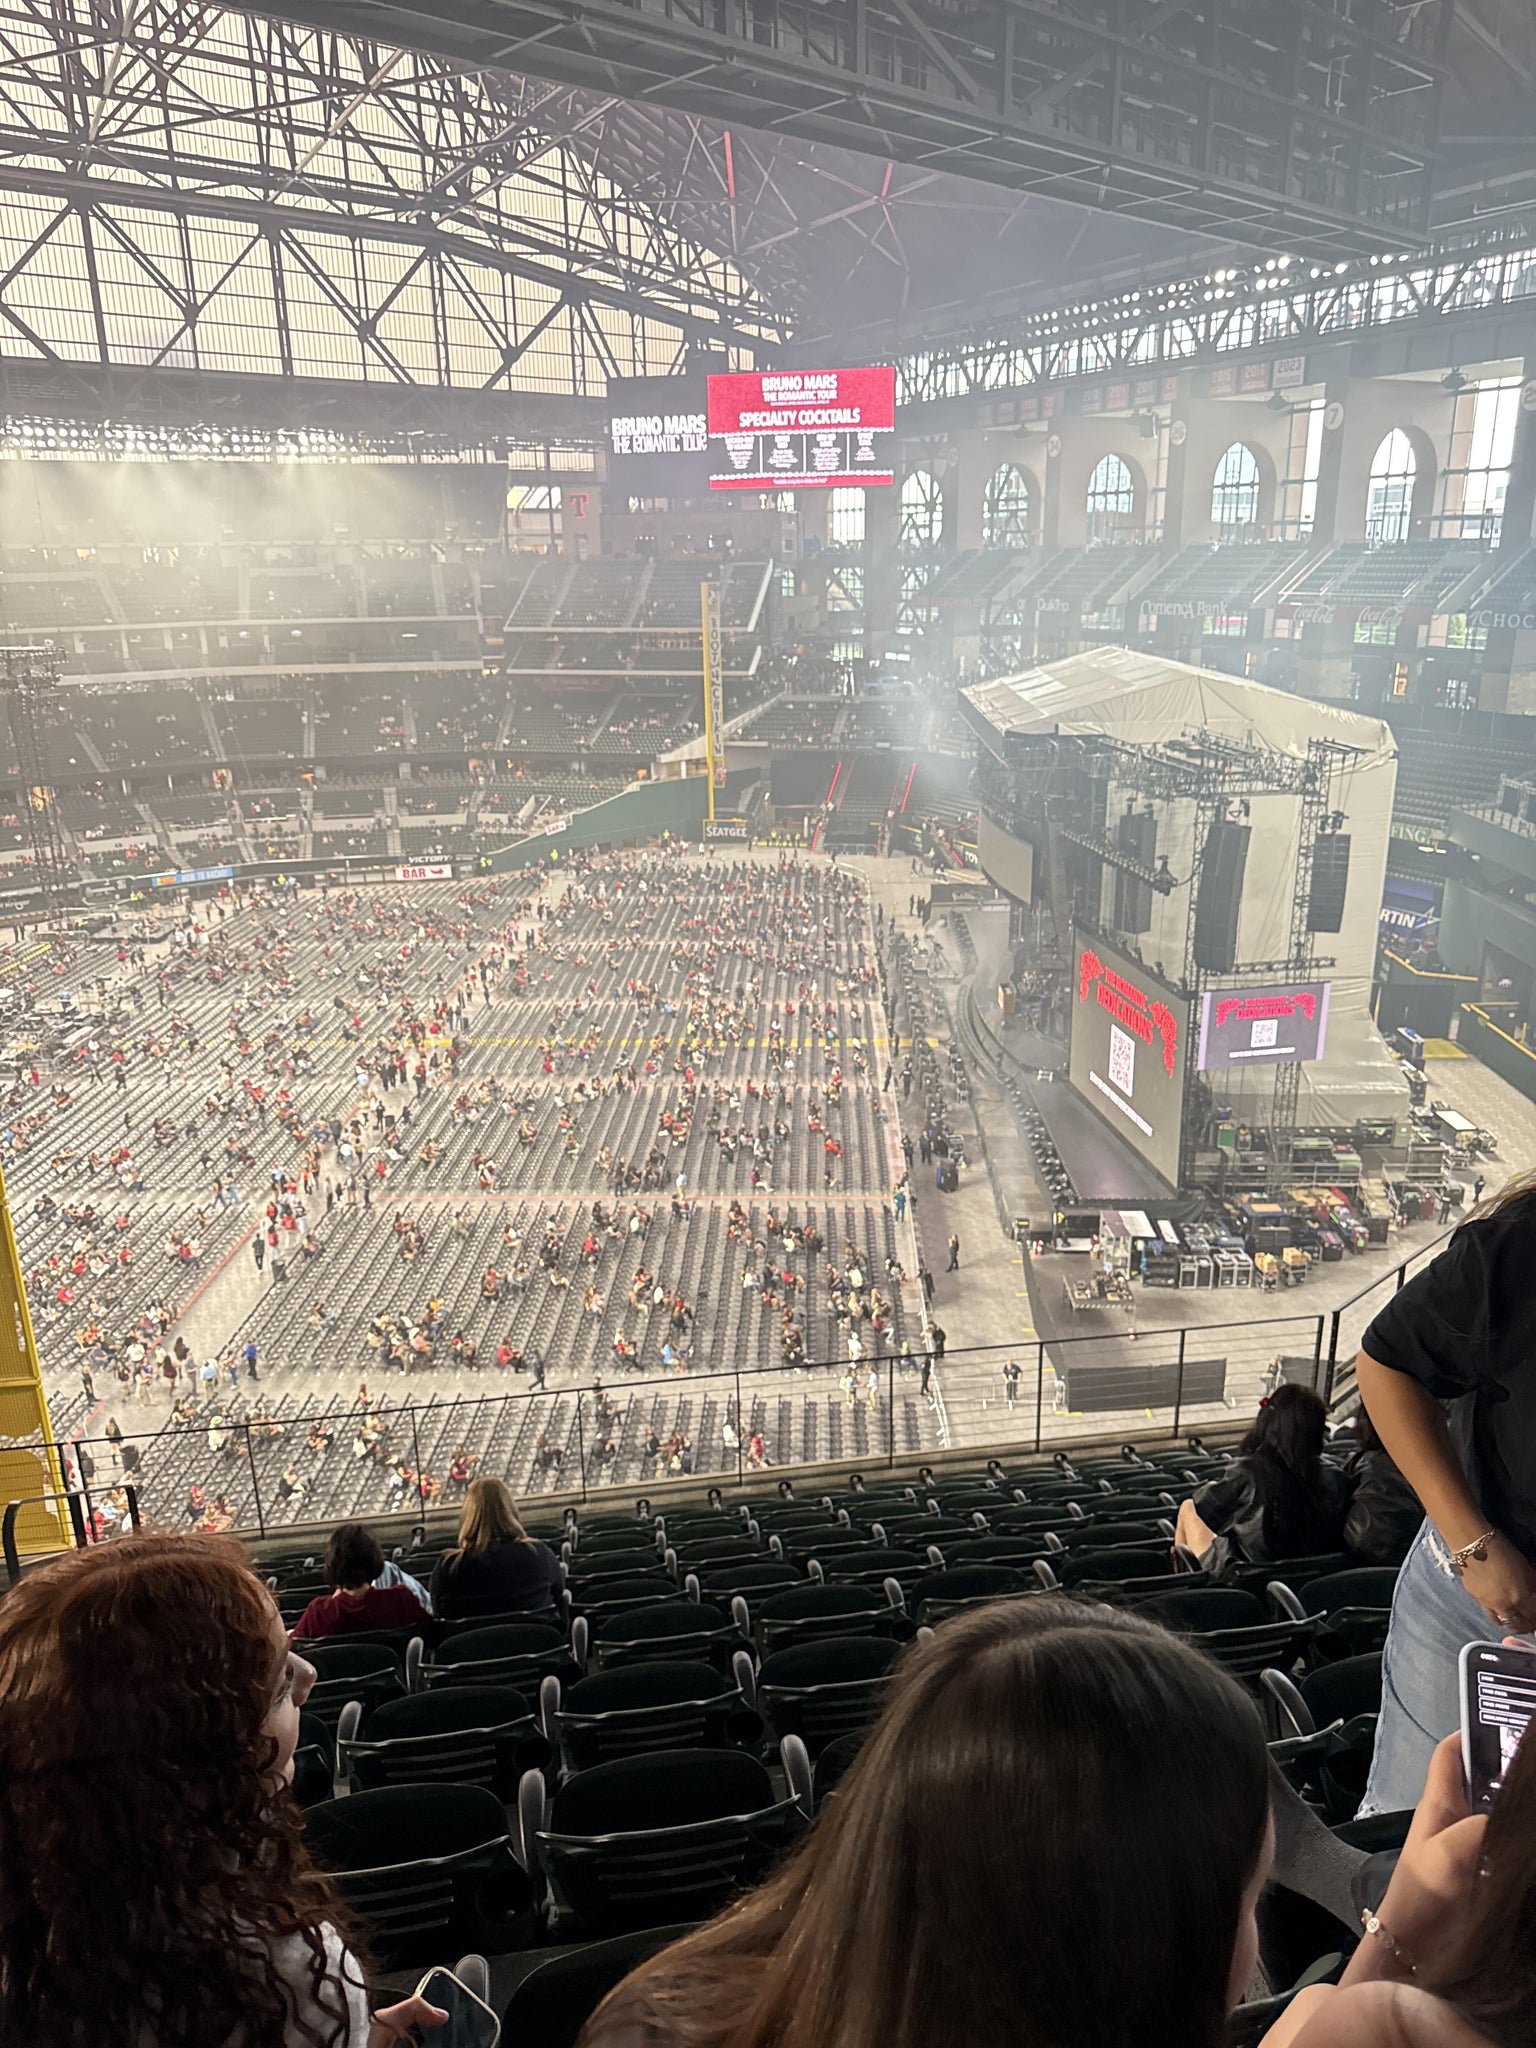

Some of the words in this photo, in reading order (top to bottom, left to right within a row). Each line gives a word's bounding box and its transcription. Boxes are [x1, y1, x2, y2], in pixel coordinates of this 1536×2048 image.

[1278, 359, 1302, 373] 2023
[762, 376, 803, 391] BRUNO
[804, 374, 838, 390] MARS
[763, 392, 778, 402] THE
[778, 390, 816, 401] ROMANTIC
[817, 390, 838, 399] TOUR
[611, 415, 663, 437] BRUNO
[663, 413, 707, 434] MARS
[739, 411, 797, 428] SPECIALTY
[798, 408, 861, 425] COCKTAILS
[611, 436, 632, 454] THE
[632, 434, 681, 453] ROMANTIC
[681, 432, 708, 452] TOUR
[568, 493, 590, 519] T
[1196, 601, 1230, 616] Bank
[408, 855, 451, 863] VICTORY
[402, 868, 426, 879] BAR
[1380, 908, 1416, 929] RTIN
[1097, 980, 1153, 1045] DEDICATIONS
[1236, 1004, 1296, 1020] DEDICATIONS
